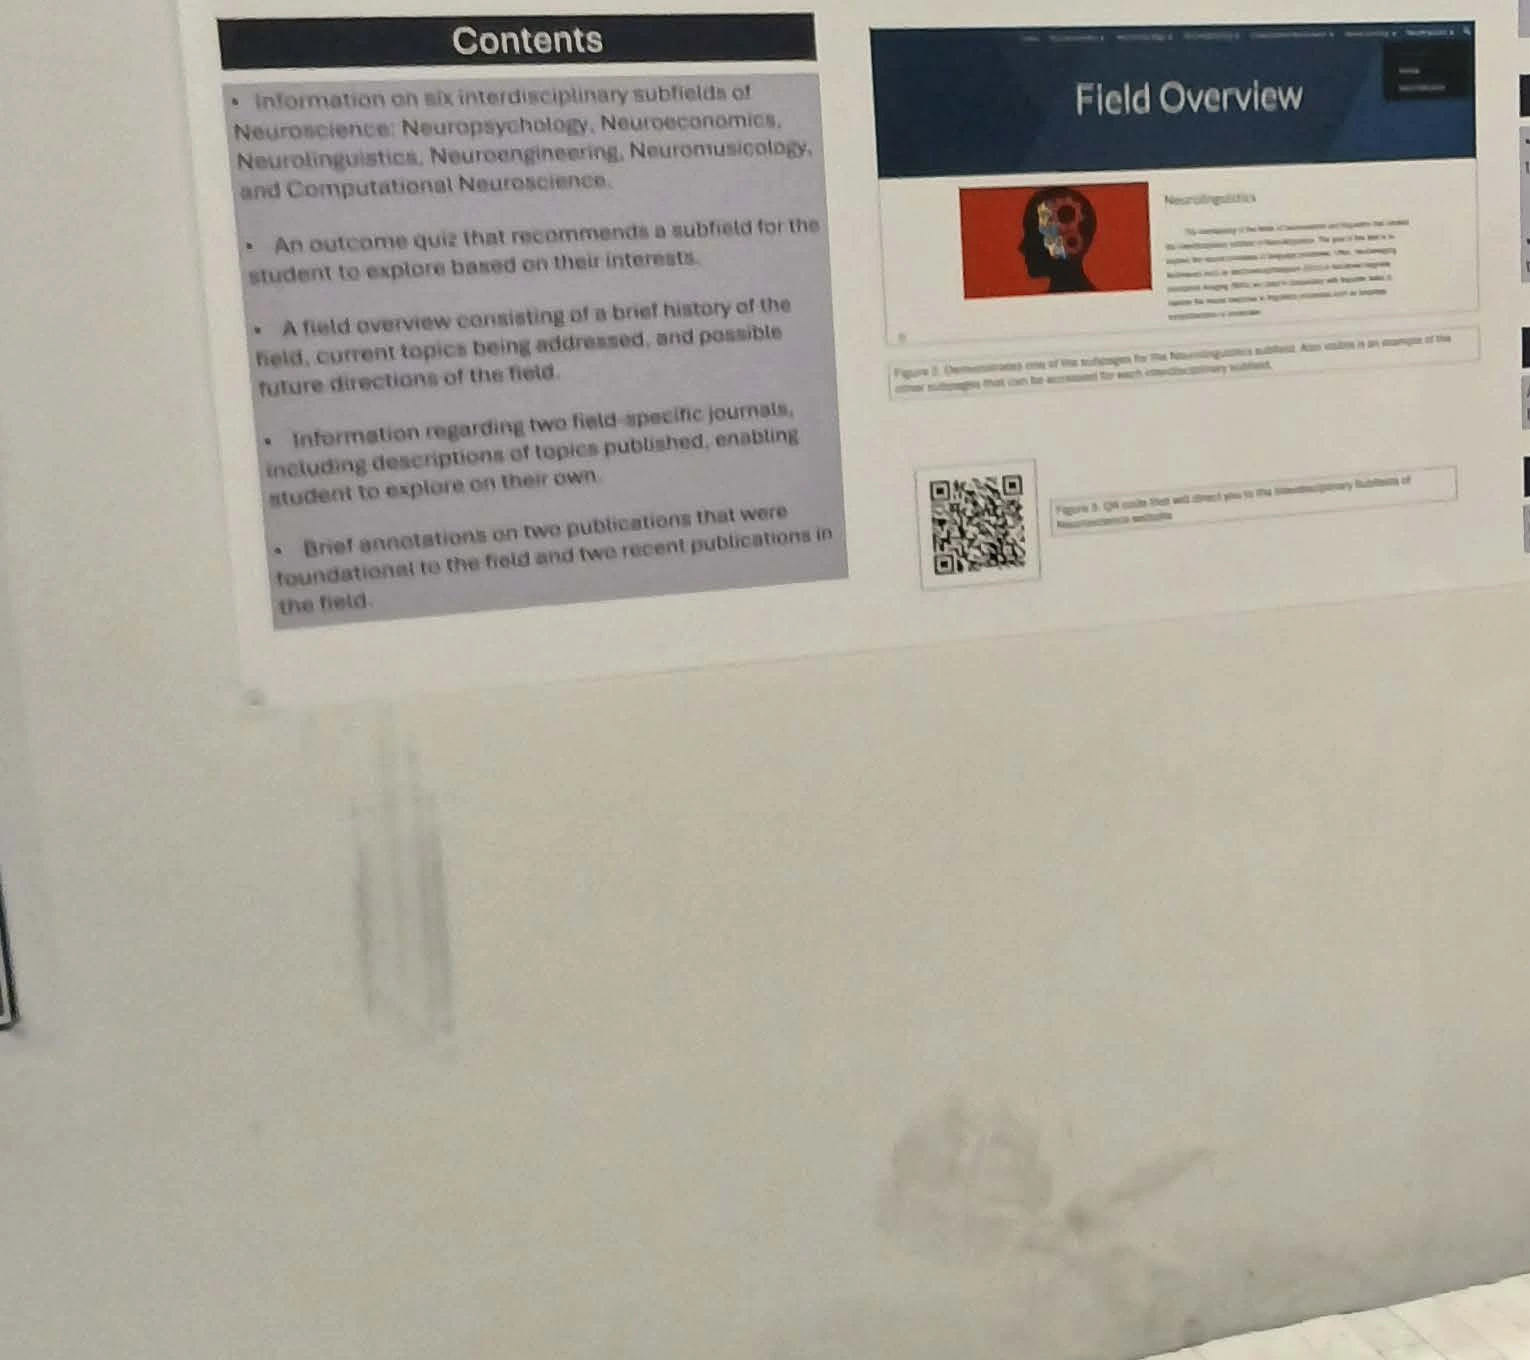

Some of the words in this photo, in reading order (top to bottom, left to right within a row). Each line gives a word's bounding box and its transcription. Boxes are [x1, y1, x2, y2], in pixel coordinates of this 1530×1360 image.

[451, 25, 603, 54] Contents
[254, 91, 386, 110] Information
[389, 91, 419, 108] on
[423, 89, 454, 107] six
[456, 87, 629, 107] interdisciplinary
[631, 83, 727, 103] subfields
[730, 82, 751, 101] of
[1075, 81, 1150, 115] Field
[1158, 80, 1303, 113] Overview
[239, 180, 281, 200] and
[285, 177, 453, 199] Computational
